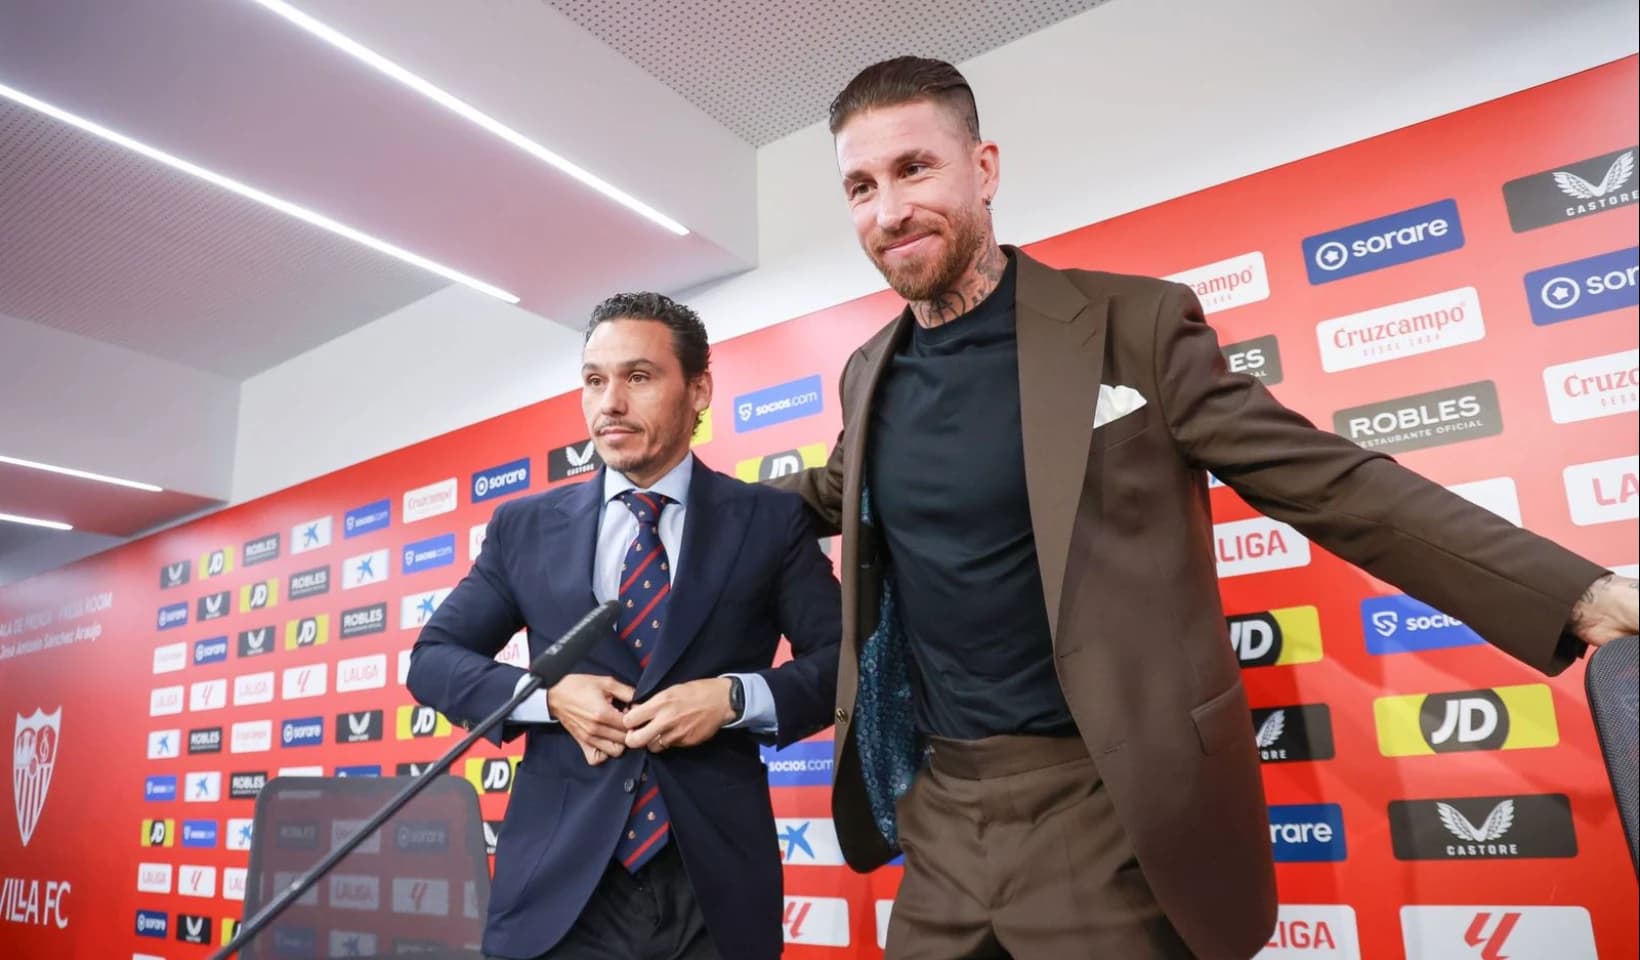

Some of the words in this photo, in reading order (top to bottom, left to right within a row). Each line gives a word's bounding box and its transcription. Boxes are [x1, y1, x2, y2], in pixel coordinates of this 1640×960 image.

[1566, 189, 1639, 217] CASTORE
[1351, 218, 1449, 258] sorare
[1191, 269, 1253, 297] ampo
[1586, 265, 1639, 295] sor
[1333, 306, 1465, 349] Cruzcampo
[1349, 395, 1480, 438] ROBLES
[1359, 428, 1433, 449] ESTAURANTE
[1435, 420, 1484, 435] OFICIAL
[489, 468, 527, 488] sorare
[769, 455, 799, 480] JD
[250, 583, 268, 608] JD
[343, 608, 383, 628] ROBLES
[298, 618, 317, 646] JD
[292, 724, 322, 738] sorare
[413, 707, 435, 734] JD
[1431, 698, 1498, 745] JD
[190, 731, 220, 745] ROBLES
[483, 762, 510, 789] JD
[1269, 822, 1333, 844] rare
[1446, 844, 1519, 856] CASTORE
[43, 880, 71, 929] FC
